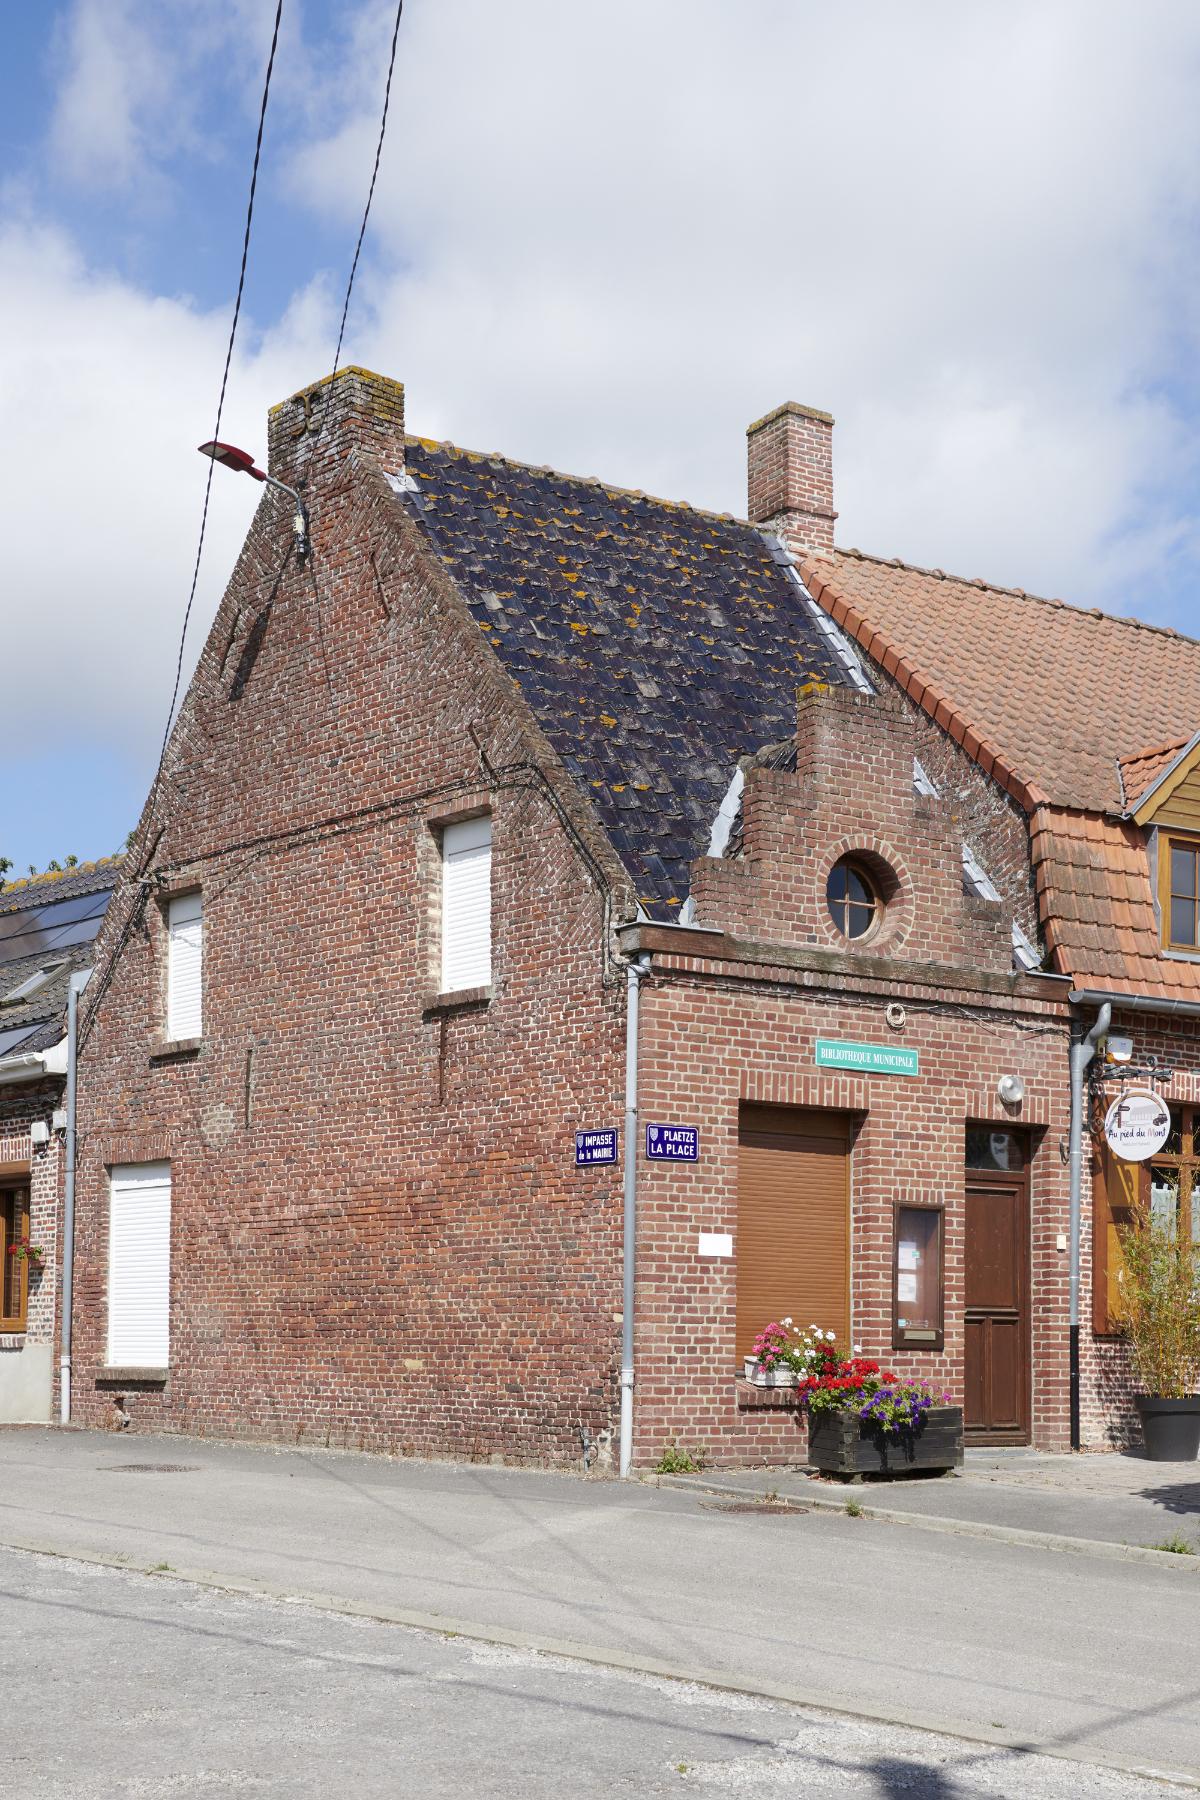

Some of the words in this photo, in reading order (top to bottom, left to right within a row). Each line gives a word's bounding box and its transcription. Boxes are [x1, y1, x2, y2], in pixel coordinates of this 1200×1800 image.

[821, 1048, 872, 1064] BIBLIOTHEQUE
[873, 1053, 913, 1067] MUNICIPALE
[585, 1134, 613, 1147] IMPASSE
[664, 1130, 695, 1143] PLAETZE
[1108, 1129, 1118, 1138] Au
[1120, 1128, 1134, 1141] pied
[1136, 1128, 1145, 1138] du
[1147, 1127, 1166, 1138] Mont
[579, 1150, 585, 1160] de
[586, 1149, 591, 1160] la
[592, 1147, 613, 1159] MAIRIE
[651, 1143, 663, 1154] LA
[666, 1144, 695, 1156] PLACE
